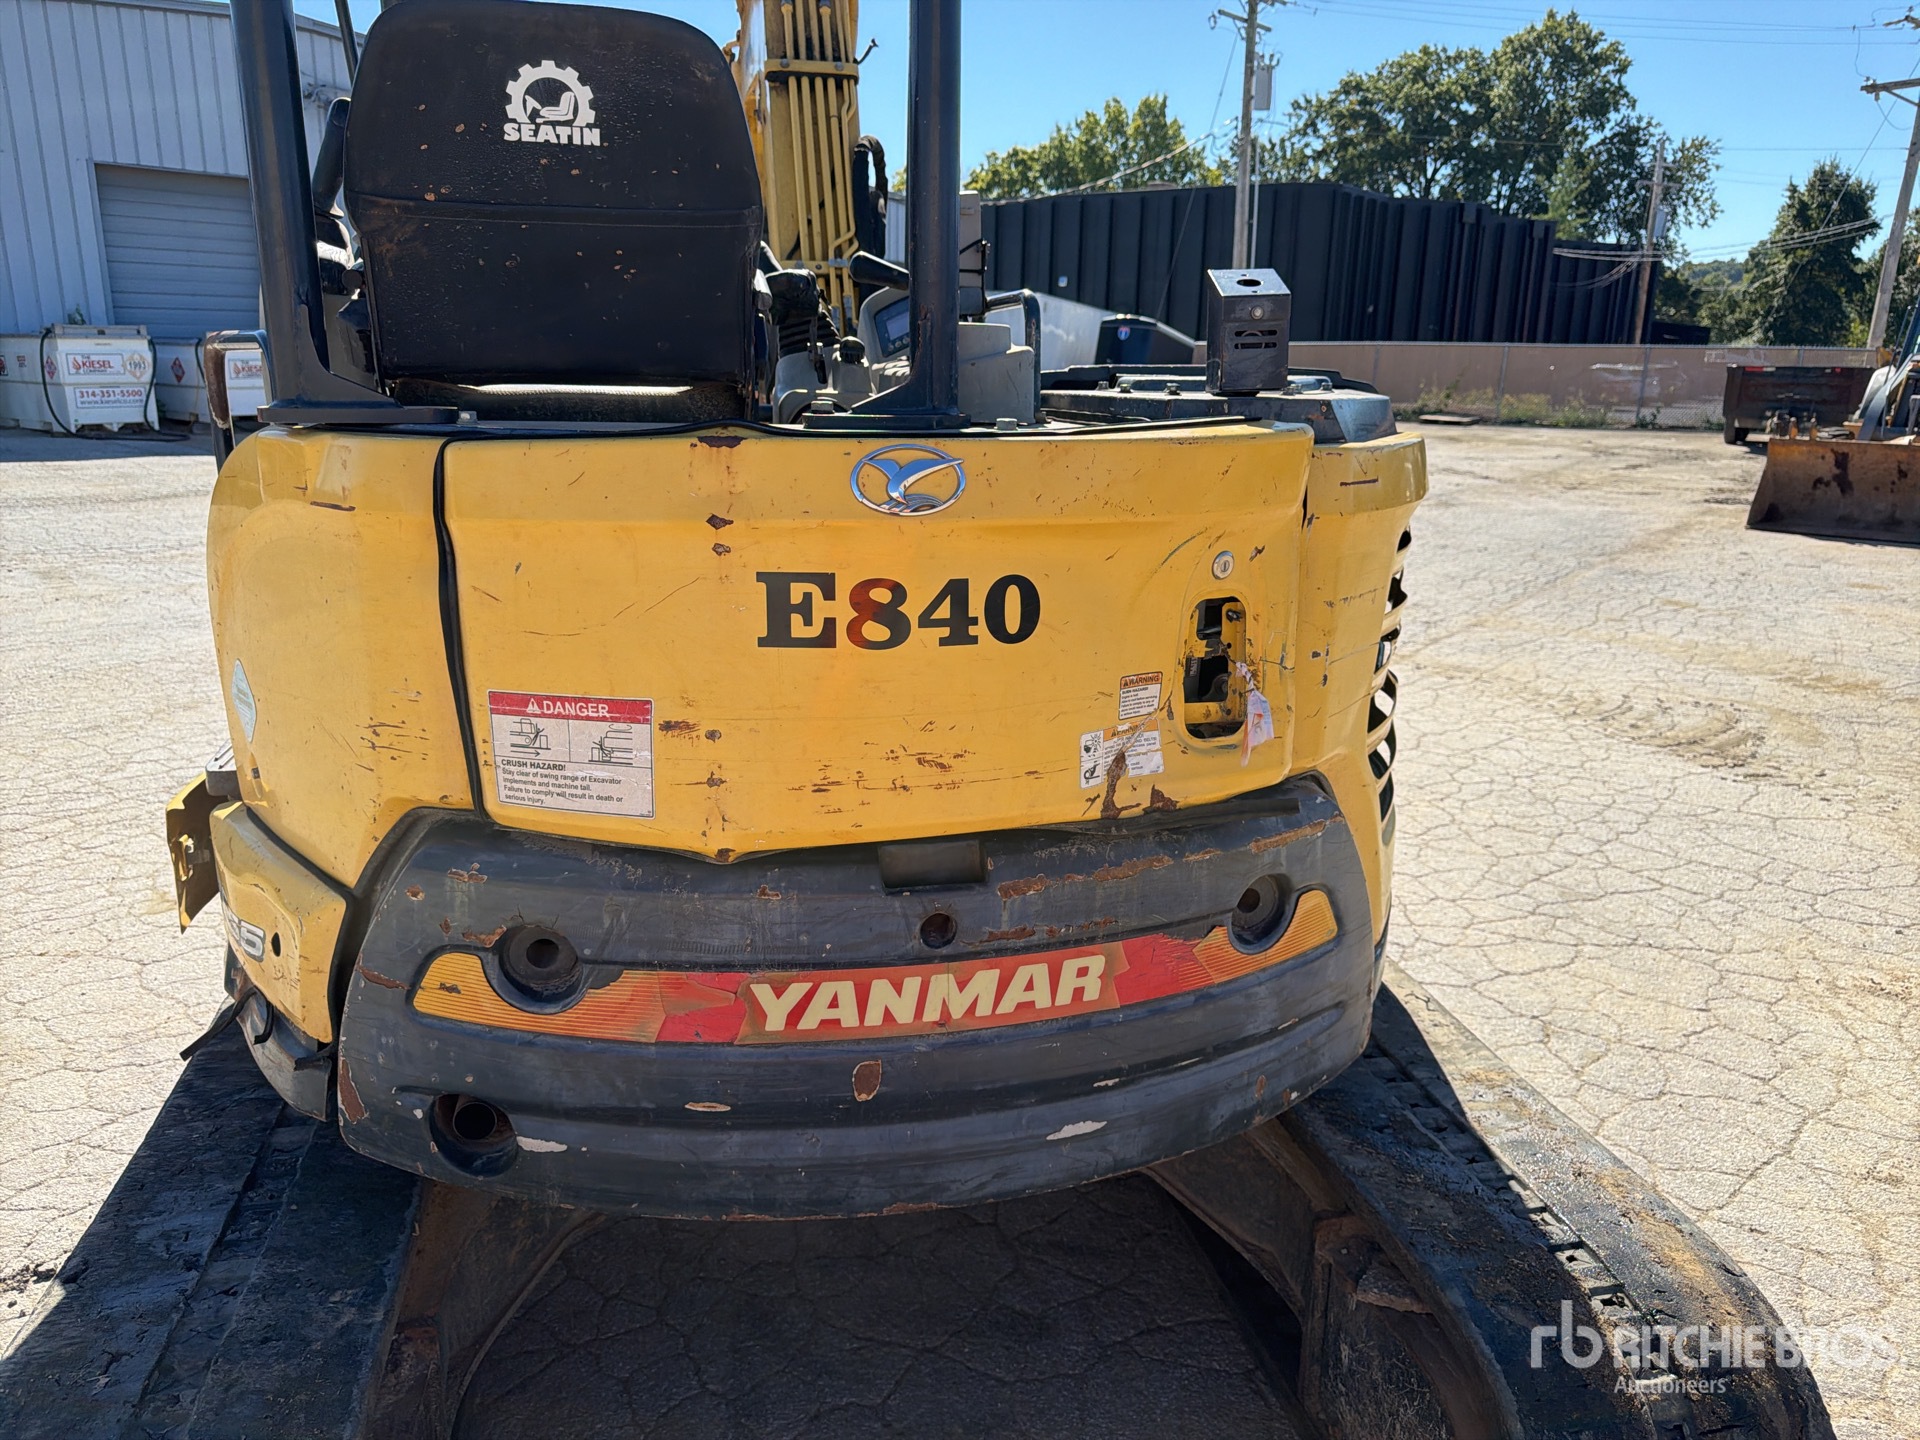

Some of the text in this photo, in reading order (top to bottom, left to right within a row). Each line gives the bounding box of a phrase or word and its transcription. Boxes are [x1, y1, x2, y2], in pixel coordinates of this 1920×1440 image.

[503, 122, 601, 147] SEATIN
[81, 359, 114, 369] KIESEL
[79, 389, 143, 399] 314-351-5500
[756, 571, 1041, 651] E840
[542, 700, 610, 718] DANGER
[501, 758, 566, 772] CRUSH HAZARD!
[501, 767, 515, 776] Stay
[515, 769, 531, 777] clear
[540, 773, 559, 781] swing
[560, 774, 579, 783] range
[588, 776, 622, 785] Excavator
[502, 776, 537, 787] implements
[537, 780, 550, 788] and
[551, 781, 579, 790] machine
[504, 785, 523, 793] Failure
[532, 789, 554, 798] comply
[595, 794, 615, 802] death
[504, 794, 546, 805] serious injury.
[749, 954, 1106, 1032] YANMAR
